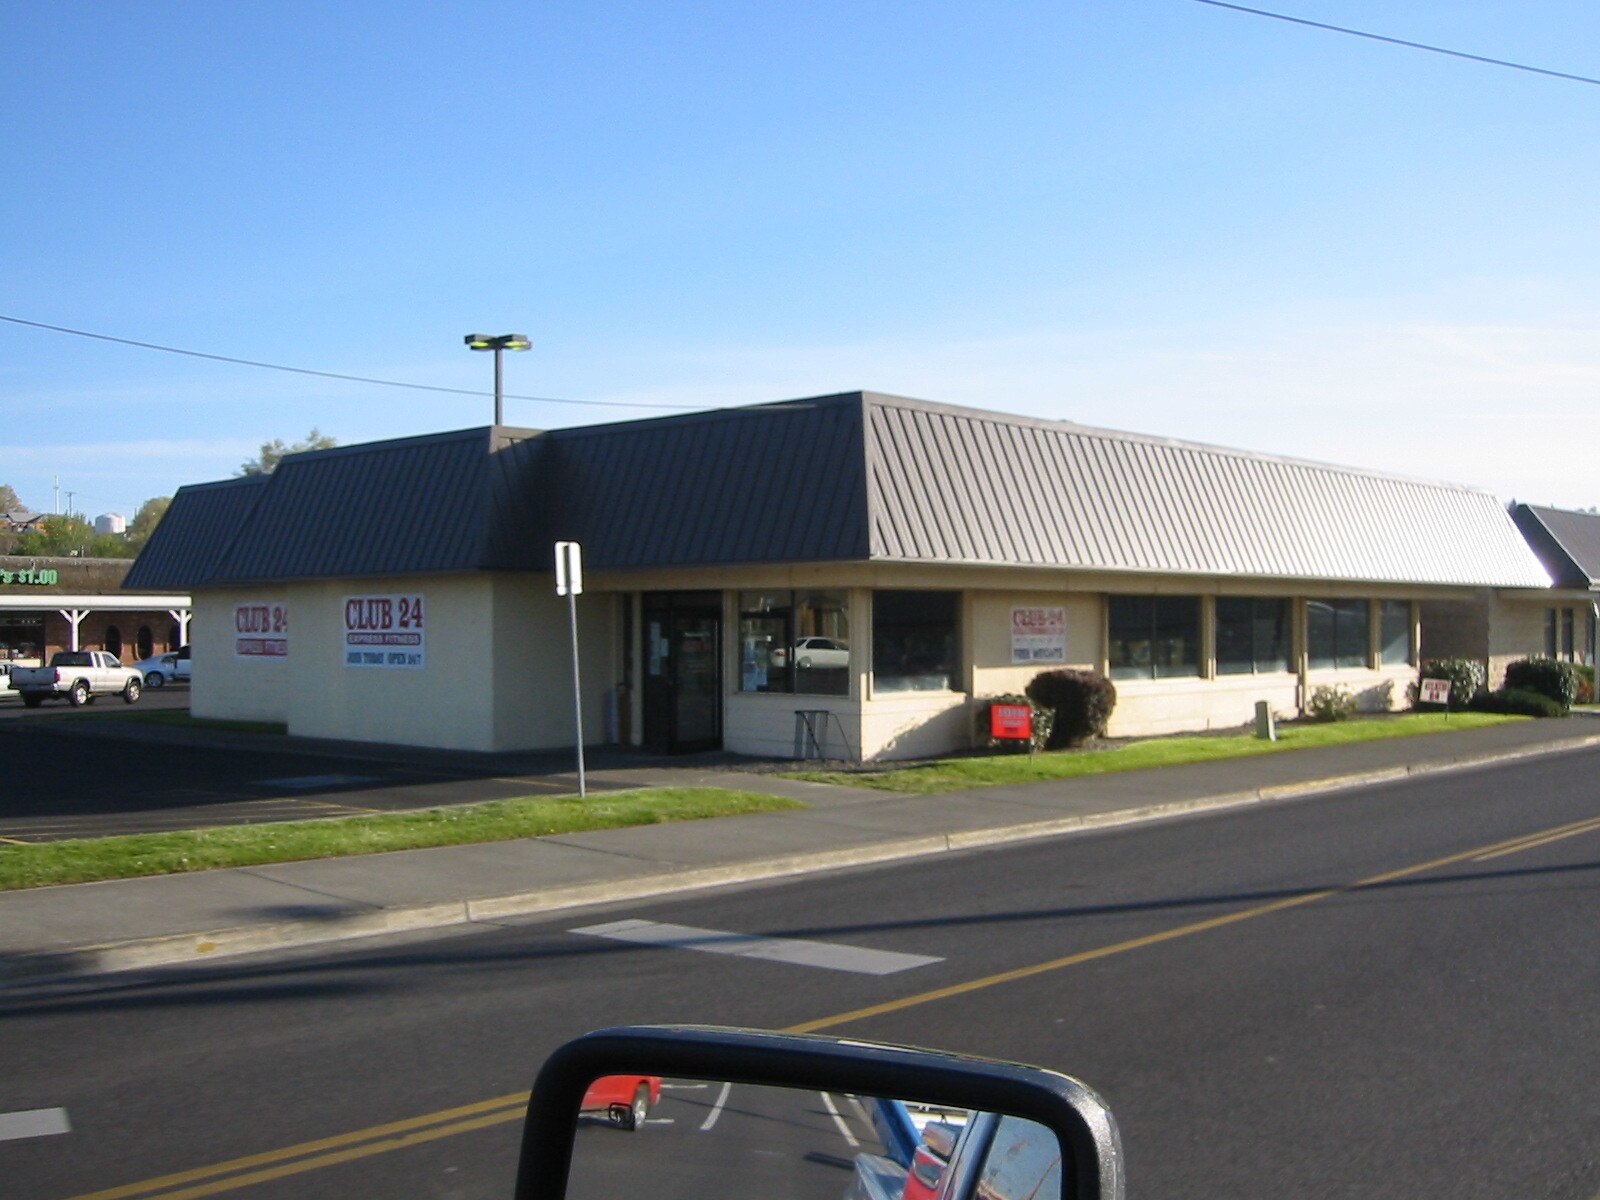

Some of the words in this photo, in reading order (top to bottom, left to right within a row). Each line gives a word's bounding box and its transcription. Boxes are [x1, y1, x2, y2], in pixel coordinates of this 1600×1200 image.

[18, 568, 58, 585] $1.00
[236, 606, 270, 632] CLUB
[346, 599, 393, 630] CLUB
[398, 597, 423, 629] 24
